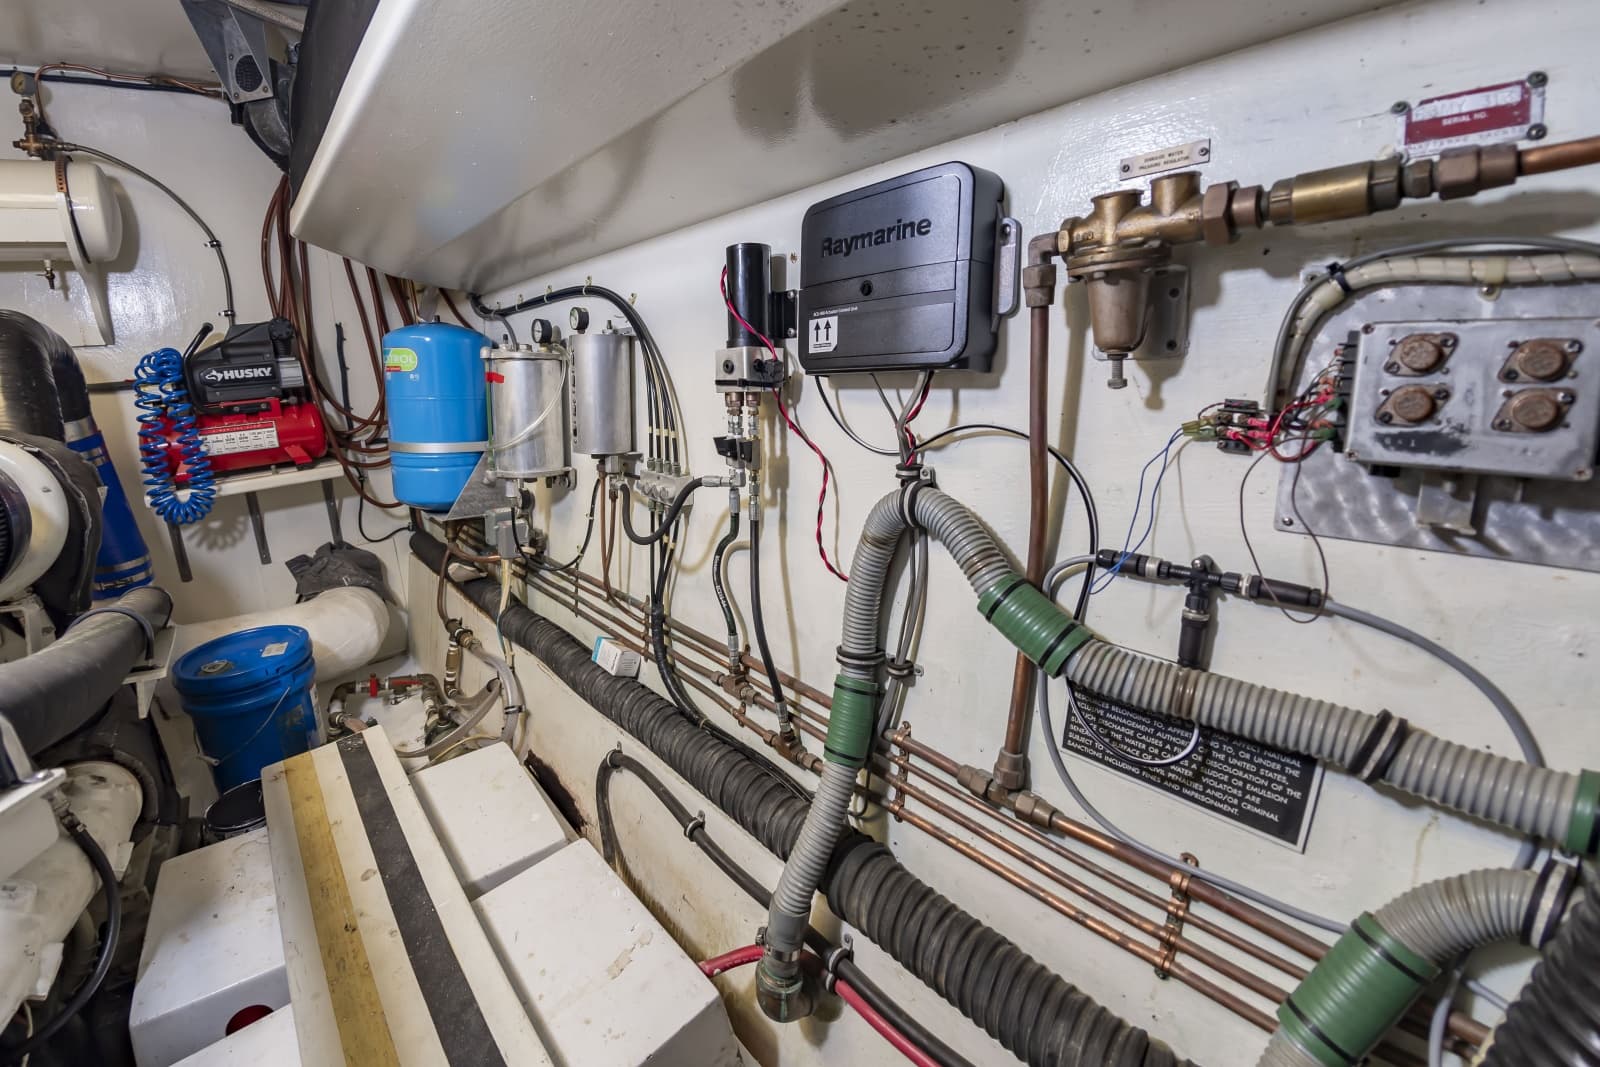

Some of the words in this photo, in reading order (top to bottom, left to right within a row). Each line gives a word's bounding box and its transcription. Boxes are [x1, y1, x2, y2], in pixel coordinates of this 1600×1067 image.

[821, 218, 932, 258] Raymarine
[223, 367, 272, 380] HUSKY
[1067, 740, 1102, 759] SANCTIONS
[1104, 755, 1140, 774] INCLUDING
[1142, 771, 1161, 783] FINES
[1163, 781, 1180, 790] AND
[1182, 787, 1240, 816] IMPRISONMENT.
[1068, 732, 1094, 746] SUBJECT
[1095, 742, 1104, 750] TO
[1168, 772, 1203, 791] PENALTIES
[1205, 788, 1238, 805] AND/OR
[1241, 802, 1279, 822] CRIMINAL
[1106, 713, 1155, 734] MANAGEMENT
[1211, 750, 1226, 761] THE
[1228, 757, 1257, 772] UNITED
[1259, 768, 1289, 785] STATES,
[1110, 731, 1123, 741] THE
[1124, 736, 1146, 750] WATER
[1148, 746, 1159, 755] OR
[1231, 778, 1243, 787] OR
[1245, 783, 1289, 805] EMULSION
[1136, 733, 1163, 747] CAUSES
[1205, 759, 1269, 787] DISCOLORATION
[1271, 783, 1284, 792] OF
[1286, 788, 1302, 800] THE
[1142, 752, 1153, 761] OF
[1201, 776, 1243, 797] VIOLATORS
[1244, 794, 1261, 805] ARE
[1238, 751, 1251, 760] OR
[1253, 755, 1281, 771] UNDER
[1284, 766, 1301, 778] THE
[1264, 750, 1302, 768] NATURAL
